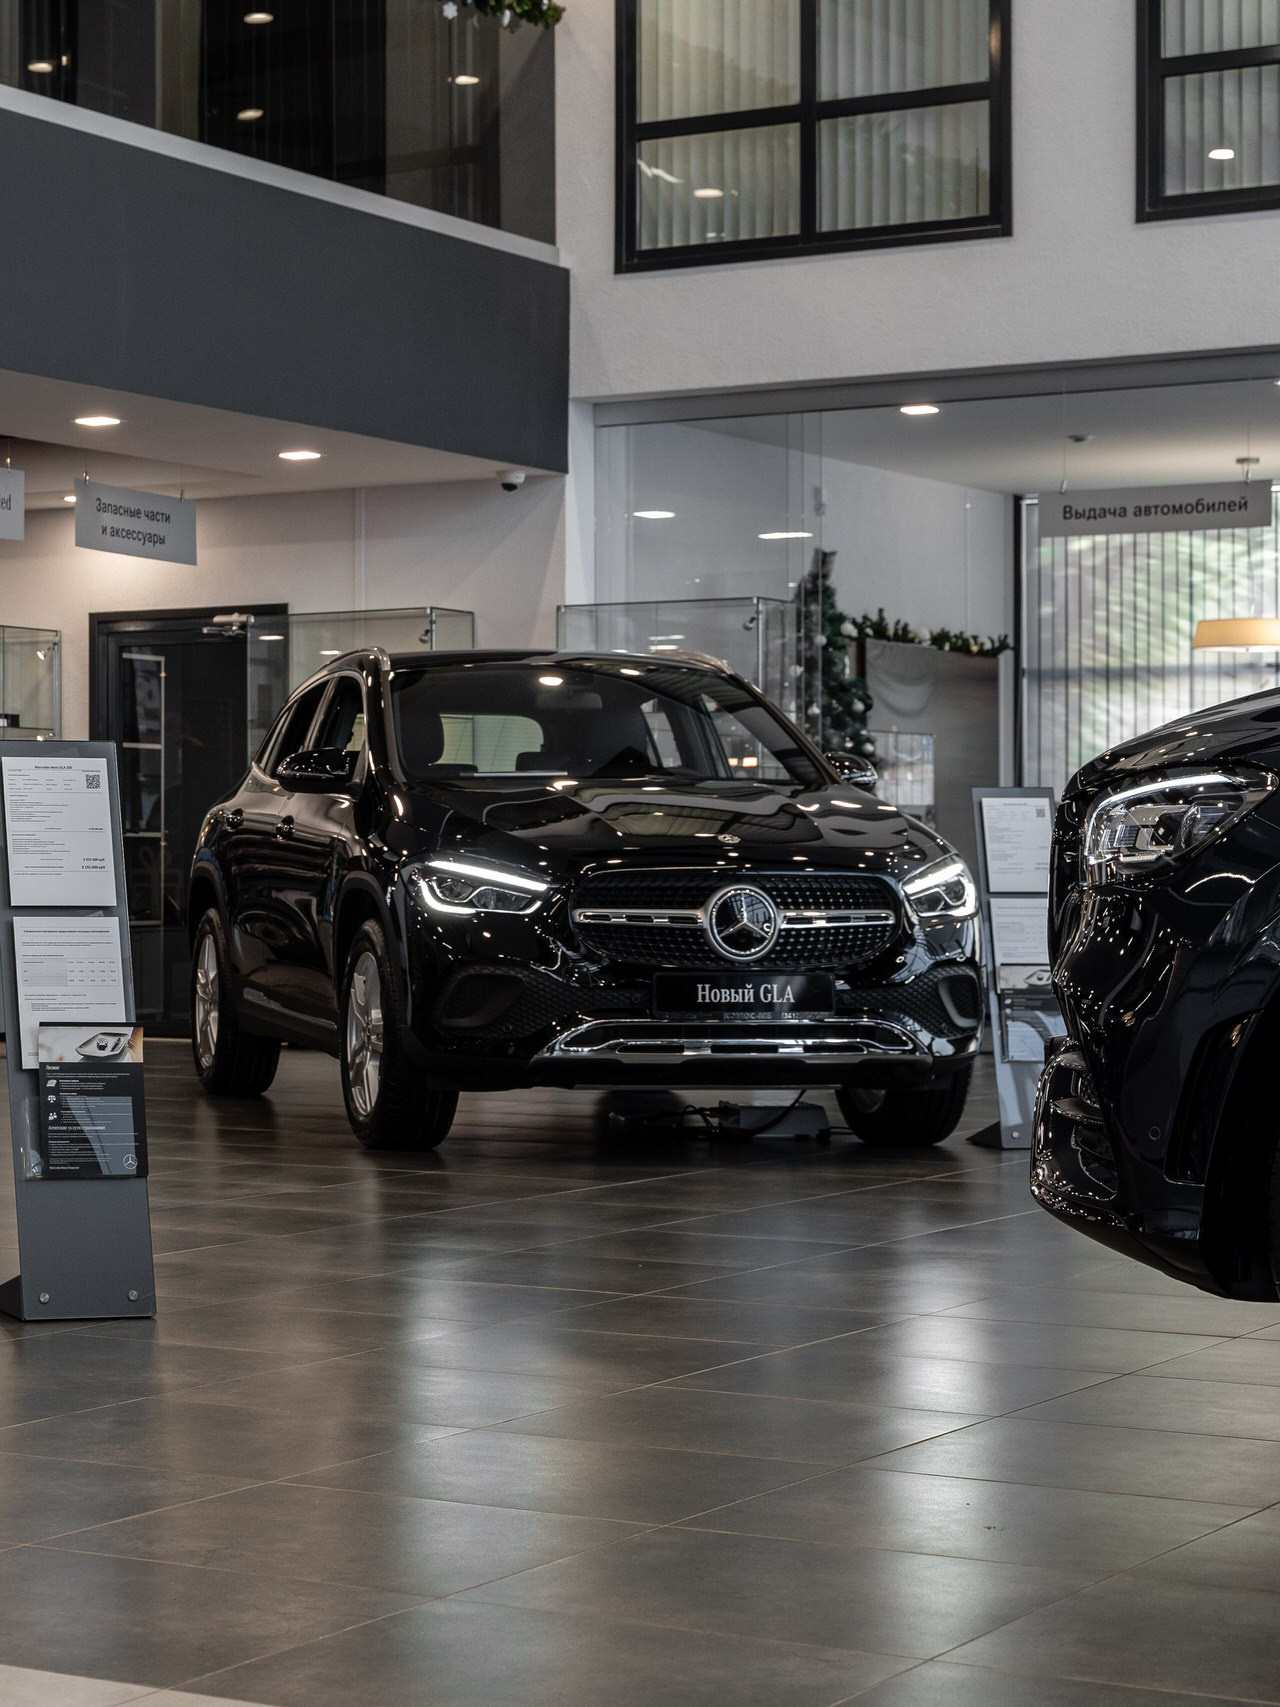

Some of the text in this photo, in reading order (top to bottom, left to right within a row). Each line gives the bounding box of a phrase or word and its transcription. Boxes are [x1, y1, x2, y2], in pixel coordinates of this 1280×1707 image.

[95, 497, 171, 524] Запасные части
[1062, 496, 1249, 521] Выдача автомобилей
[101, 524, 166, 547] и аксессуары
[697, 983, 796, 1004] Новый GLA
